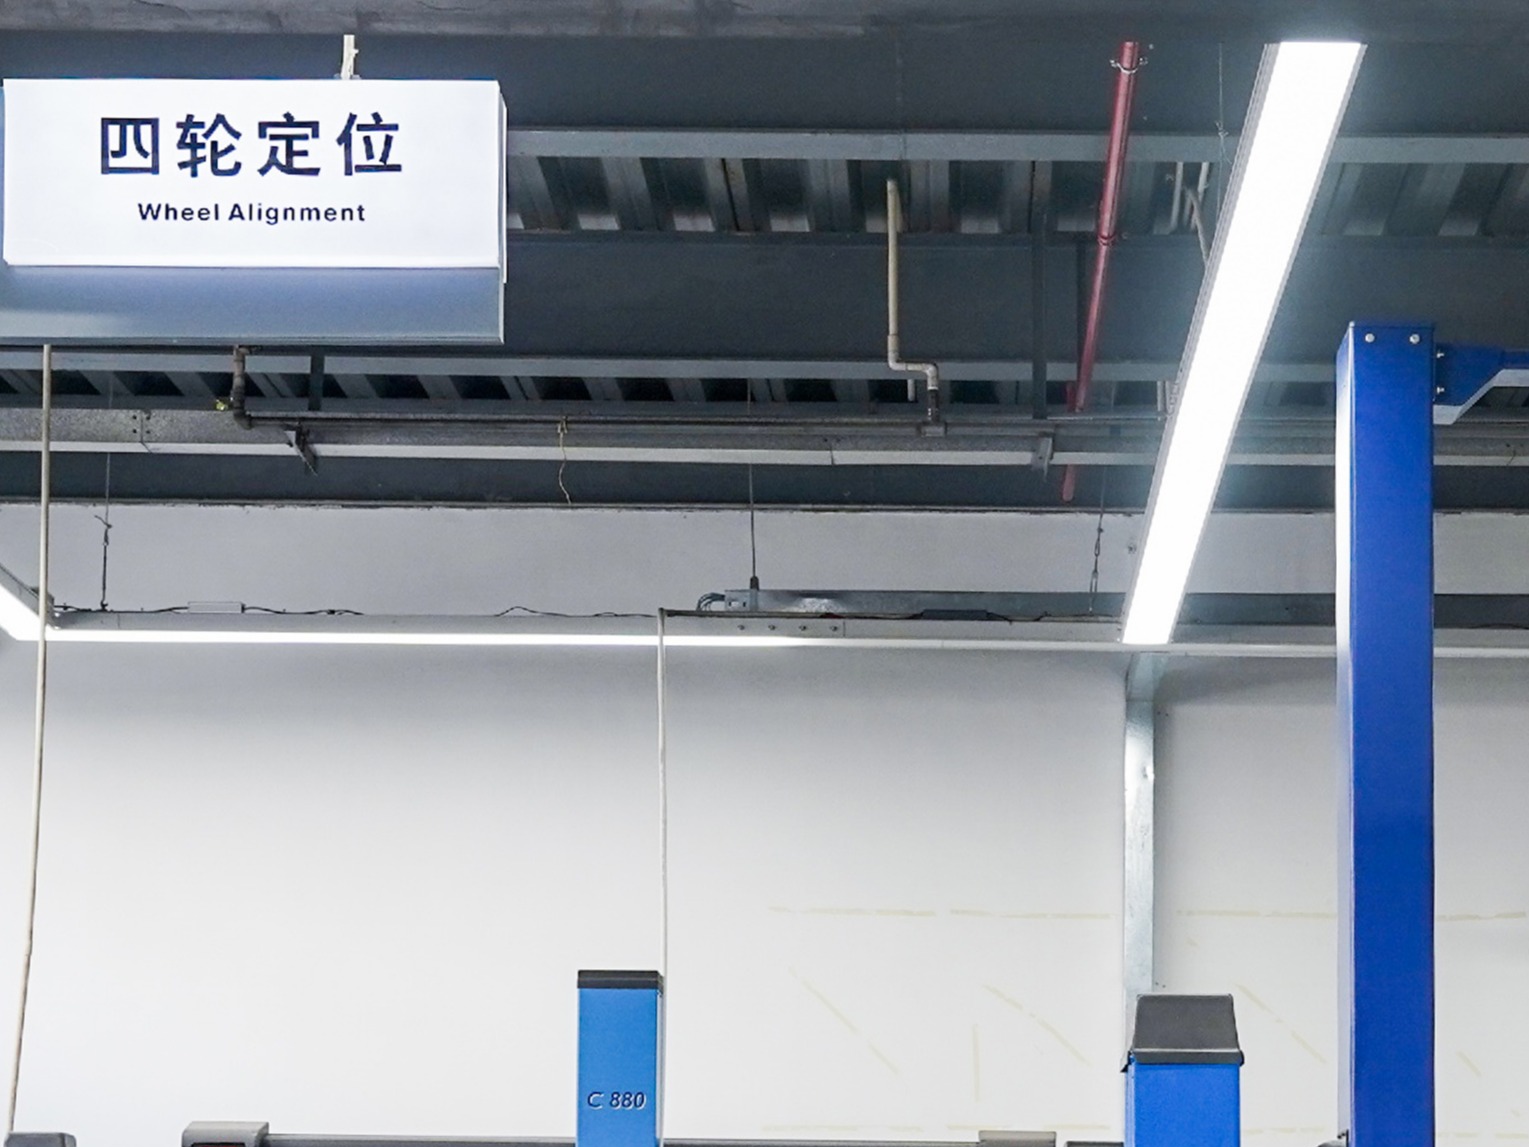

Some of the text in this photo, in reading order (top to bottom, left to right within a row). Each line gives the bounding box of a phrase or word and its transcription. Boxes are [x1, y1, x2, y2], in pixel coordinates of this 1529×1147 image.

[100, 111, 403, 178] 四轮定位
[138, 202, 366, 225] Wheel Alignment
[609, 1091, 646, 1110] 880
